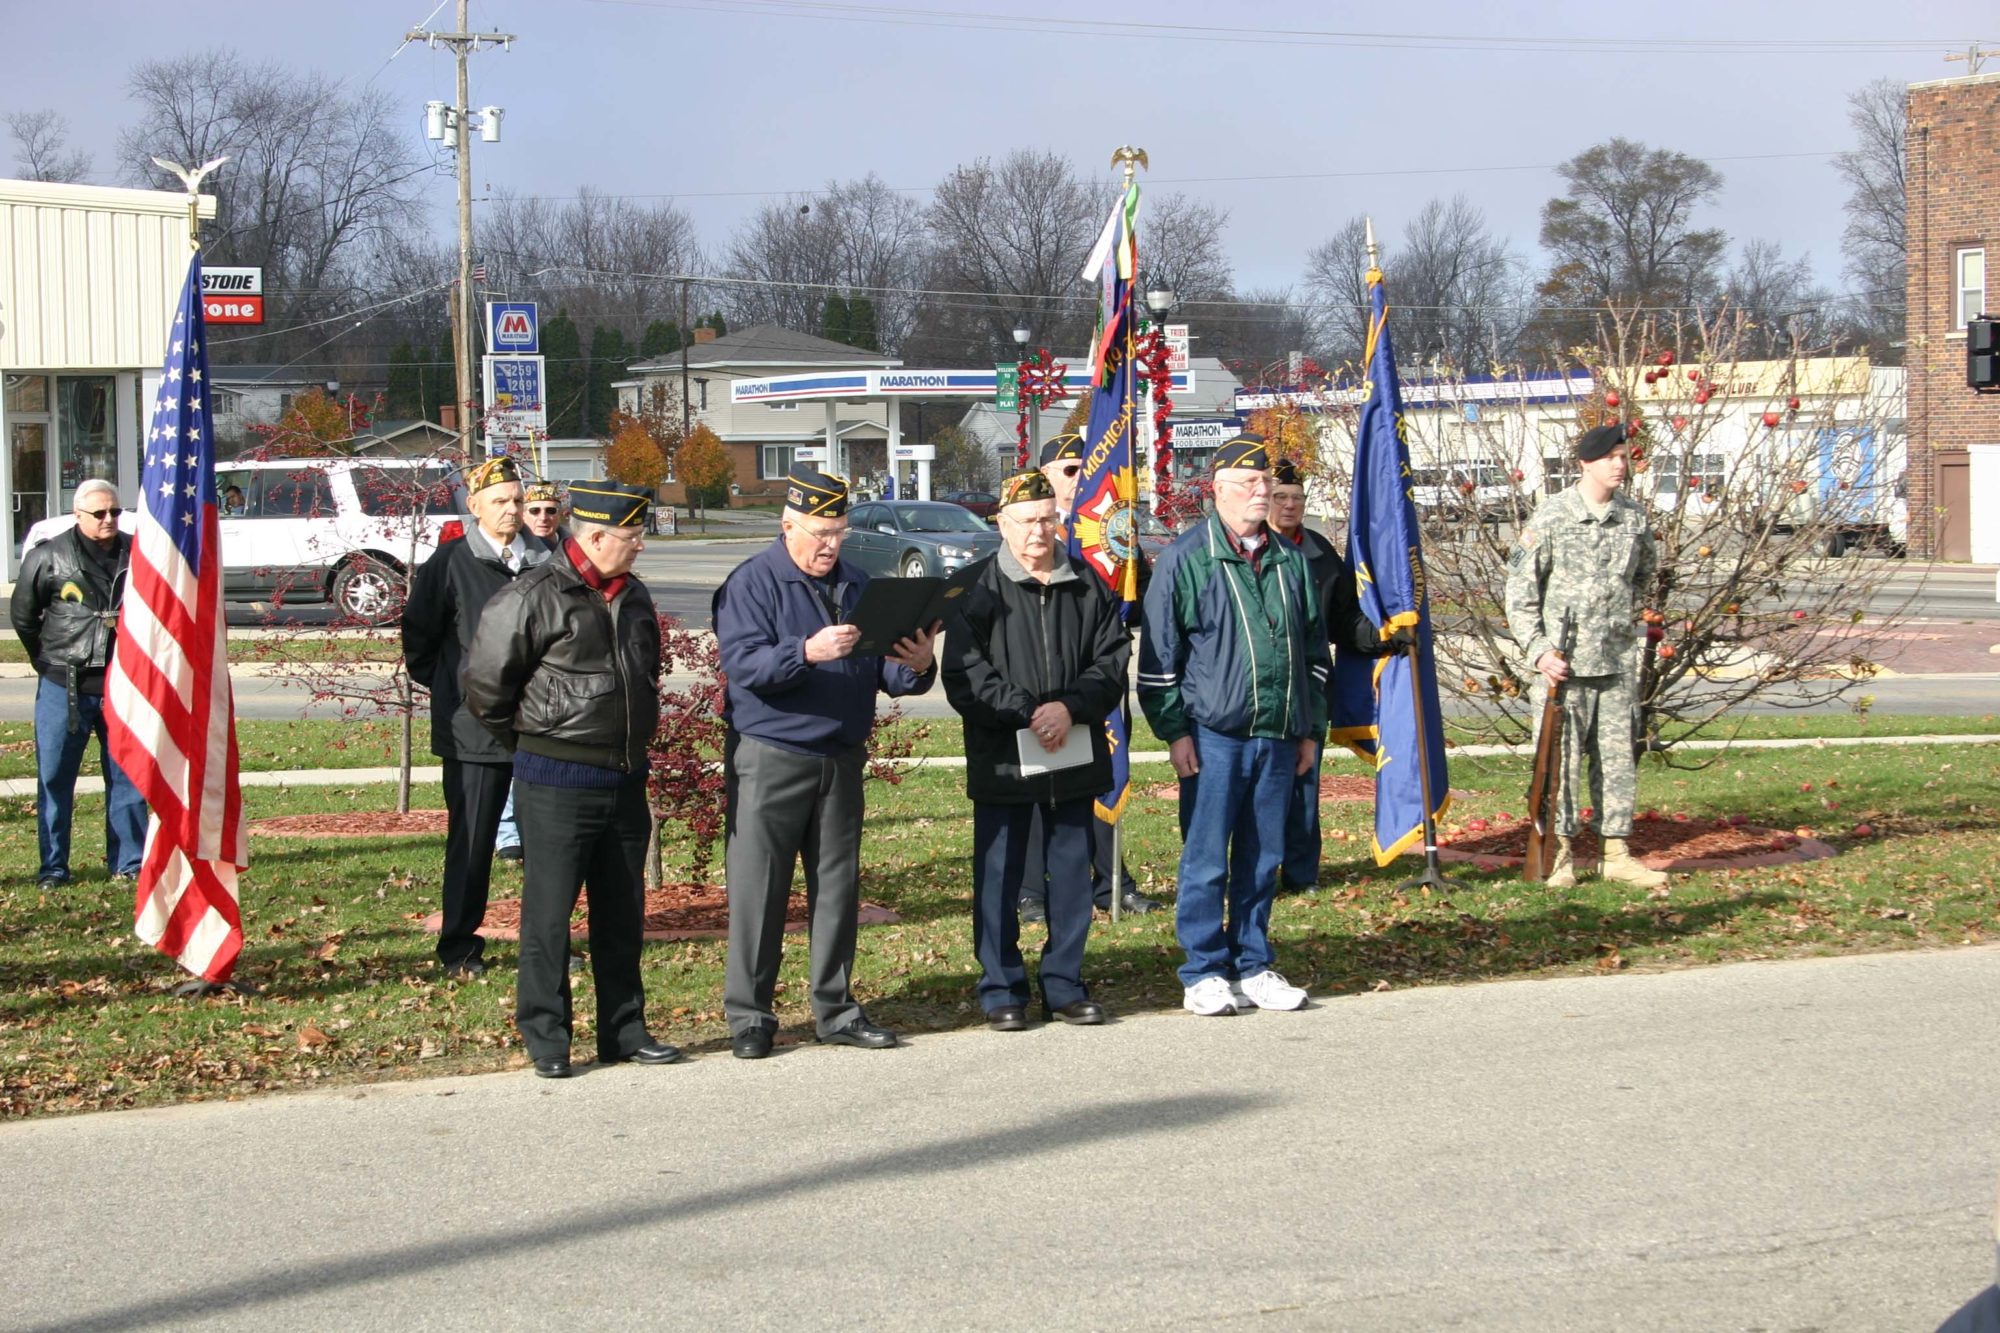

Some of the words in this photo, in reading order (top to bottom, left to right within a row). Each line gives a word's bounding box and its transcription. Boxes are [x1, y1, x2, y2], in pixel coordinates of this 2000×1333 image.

[202, 274, 254, 290] STONE
[1170, 329, 1186, 337] FRIES
[880, 376, 945, 387] MARATHON
[735, 384, 769, 395] MARATHON
[1731, 382, 1759, 395] LUBE
[1176, 425, 1220, 437] MARATHON
[1082, 398, 1137, 481] MICHIGAN
[1196, 439, 1221, 447] CENTER
[573, 507, 610, 521] COMMANDER
